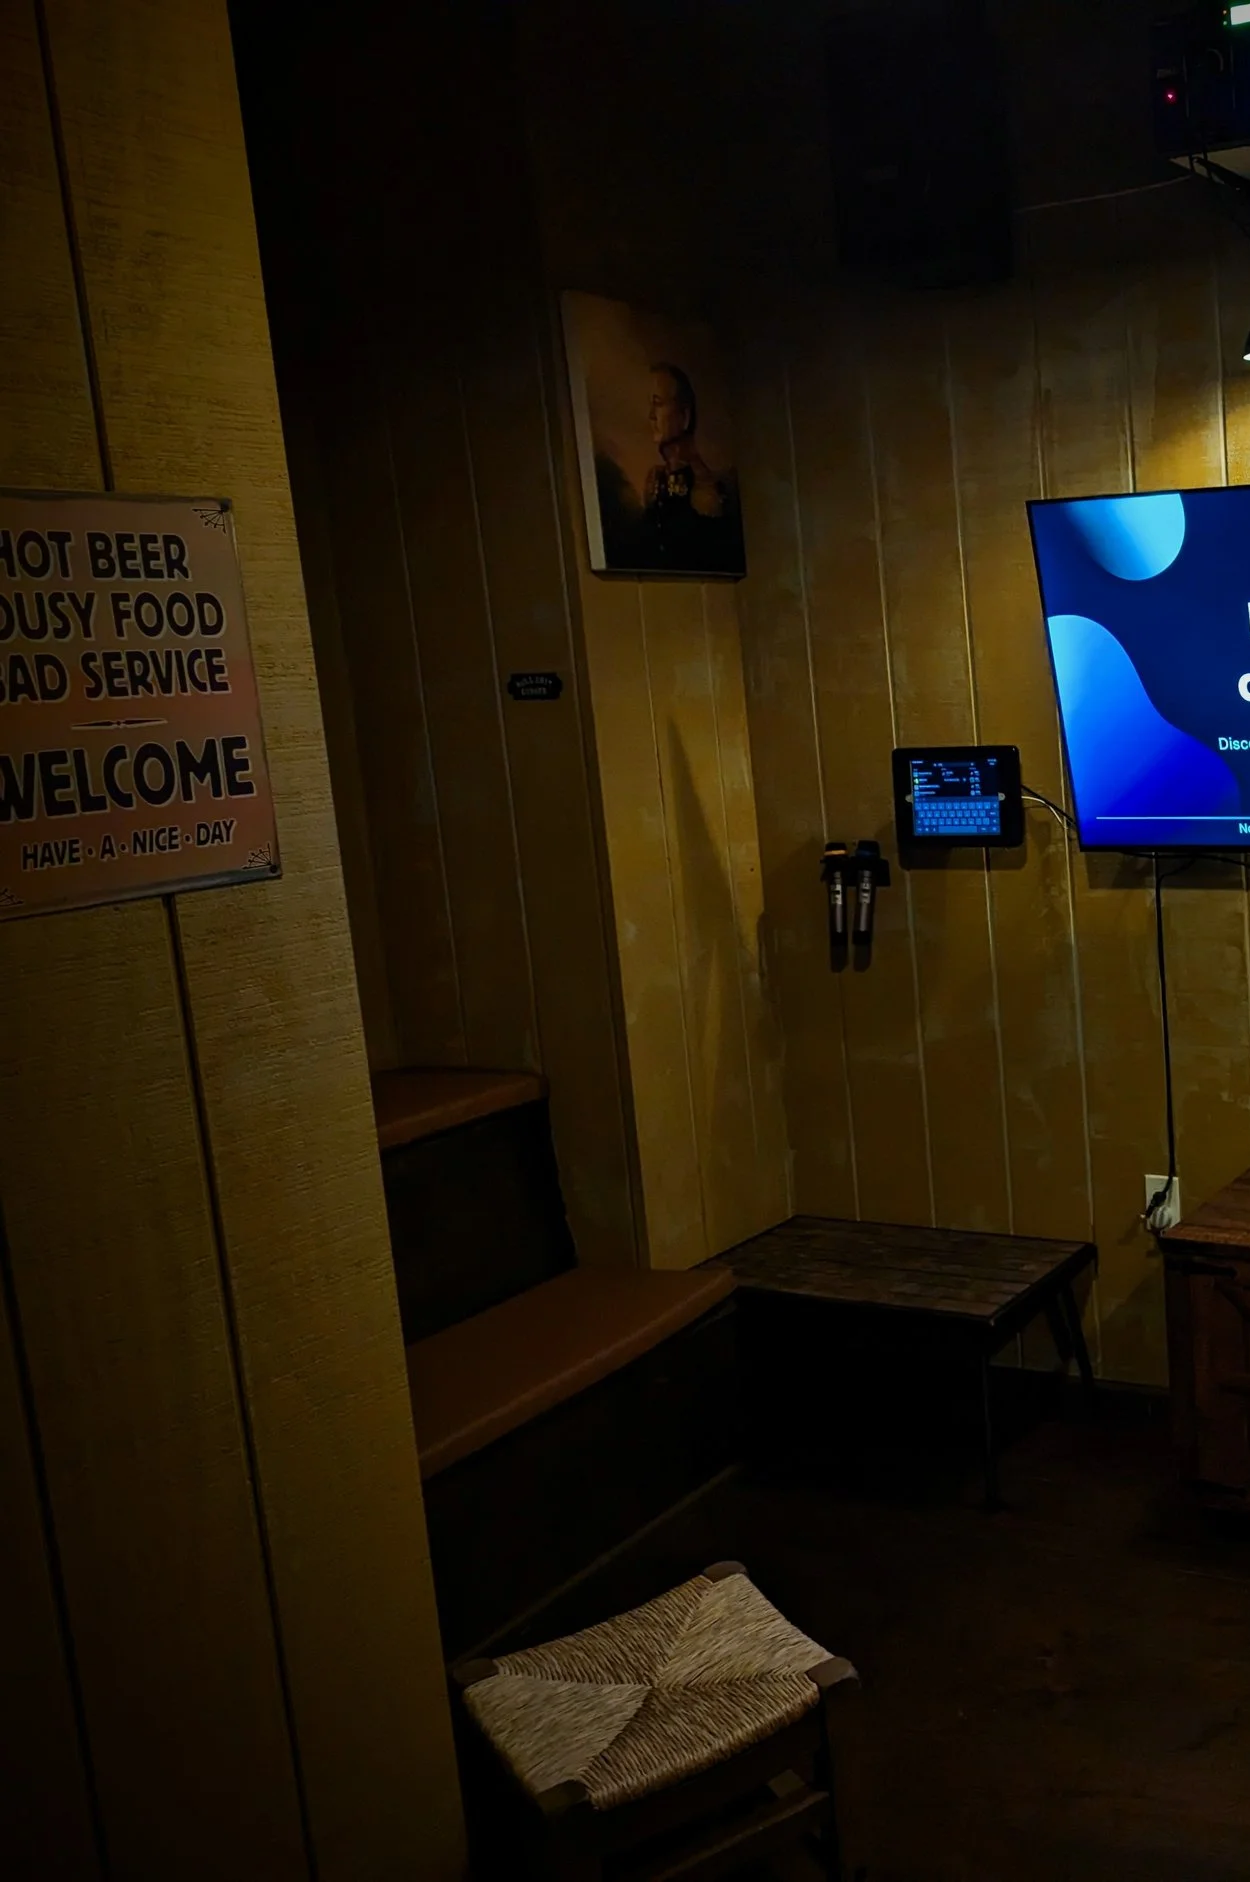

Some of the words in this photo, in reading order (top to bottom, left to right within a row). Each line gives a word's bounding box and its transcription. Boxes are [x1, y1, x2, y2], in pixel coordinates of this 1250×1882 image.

[87, 531, 190, 580] BEER
[111, 592, 224, 638] FOOD
[0, 652, 67, 702] AD
[81, 648, 229, 699] SERVICE
[0, 736, 254, 821] WELCOME
[22, 839, 81, 870] HAVE
[101, 834, 116, 859] A
[133, 826, 180, 855] NICE
[196, 819, 235, 846] DAY
